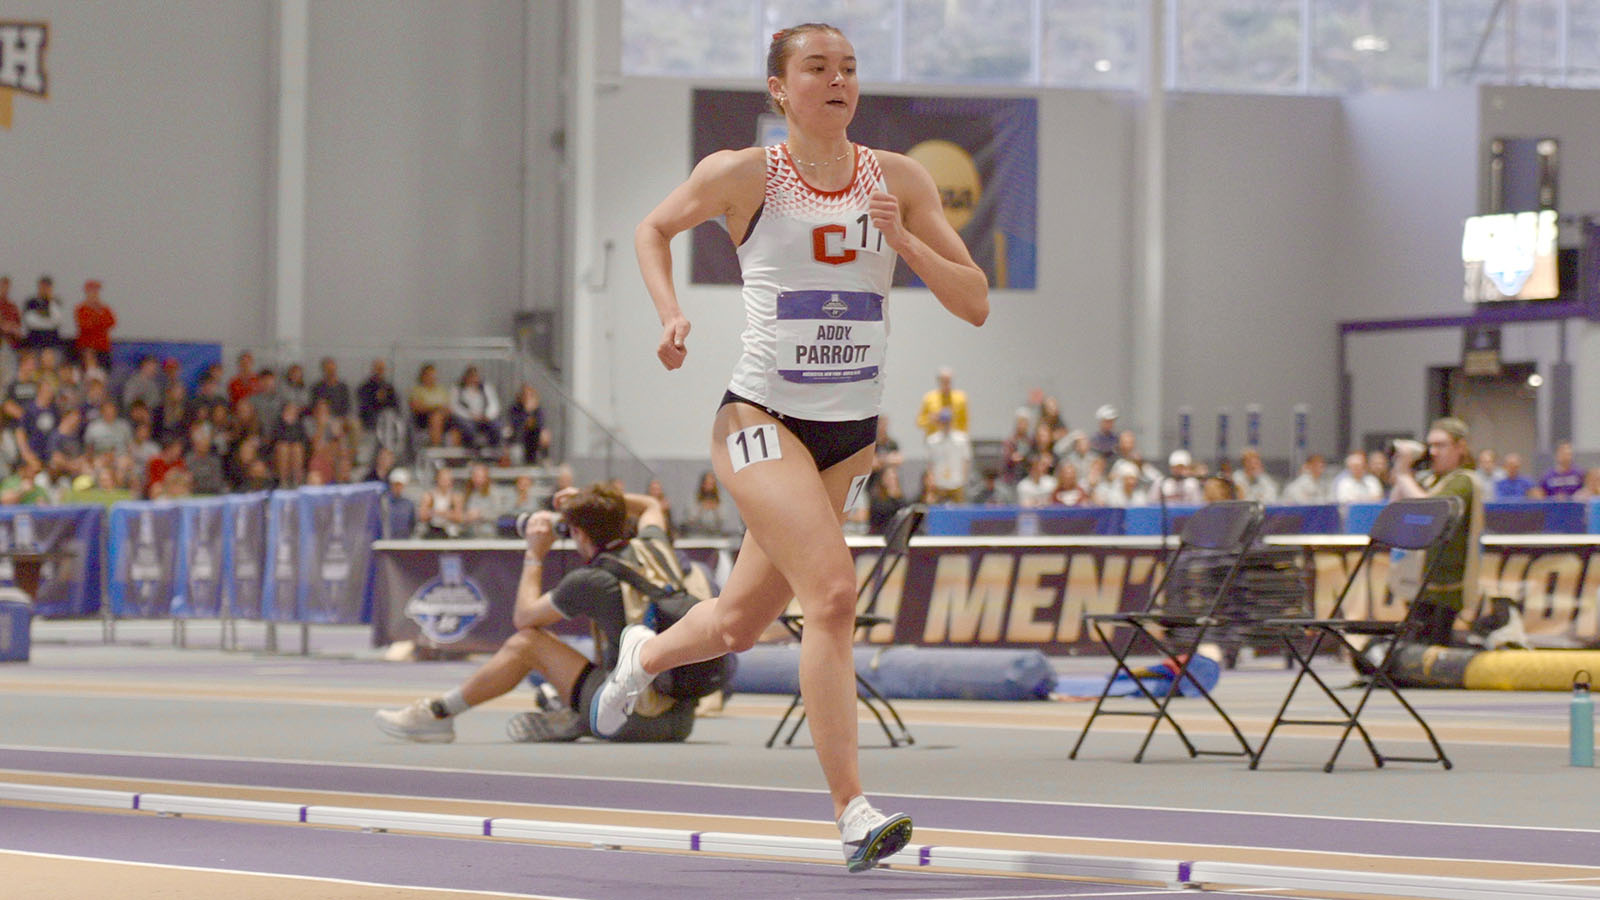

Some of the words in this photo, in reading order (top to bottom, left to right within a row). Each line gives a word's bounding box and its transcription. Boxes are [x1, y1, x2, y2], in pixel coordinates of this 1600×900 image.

[812, 225, 857, 266] C
[817, 325, 852, 340] ADDY
[796, 345, 870, 364] PARROTT
[735, 427, 768, 463] 11
